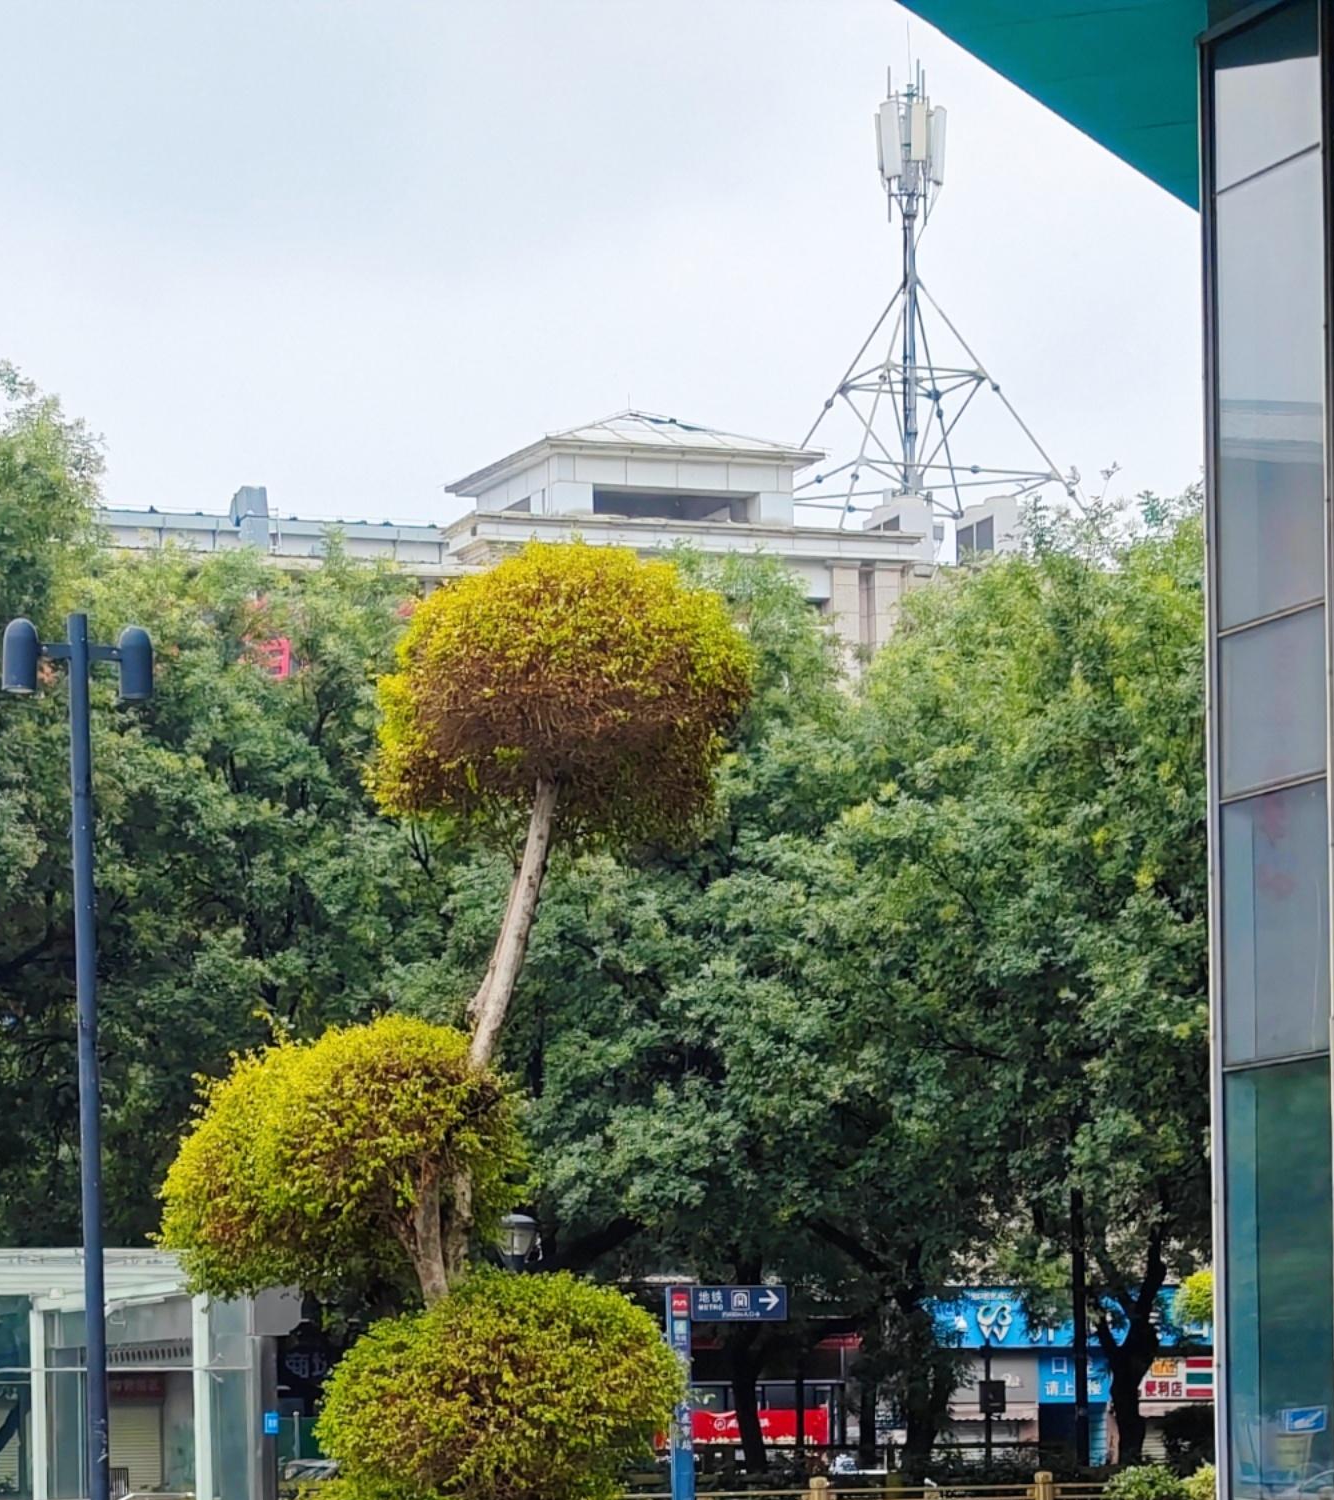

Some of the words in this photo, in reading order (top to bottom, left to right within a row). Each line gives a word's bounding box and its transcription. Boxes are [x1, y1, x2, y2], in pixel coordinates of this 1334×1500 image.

[698, 1290, 723, 1303] 地铁
[1044, 1380, 1102, 1397] 请上楼
[1145, 1380, 1182, 1397] 便利店
